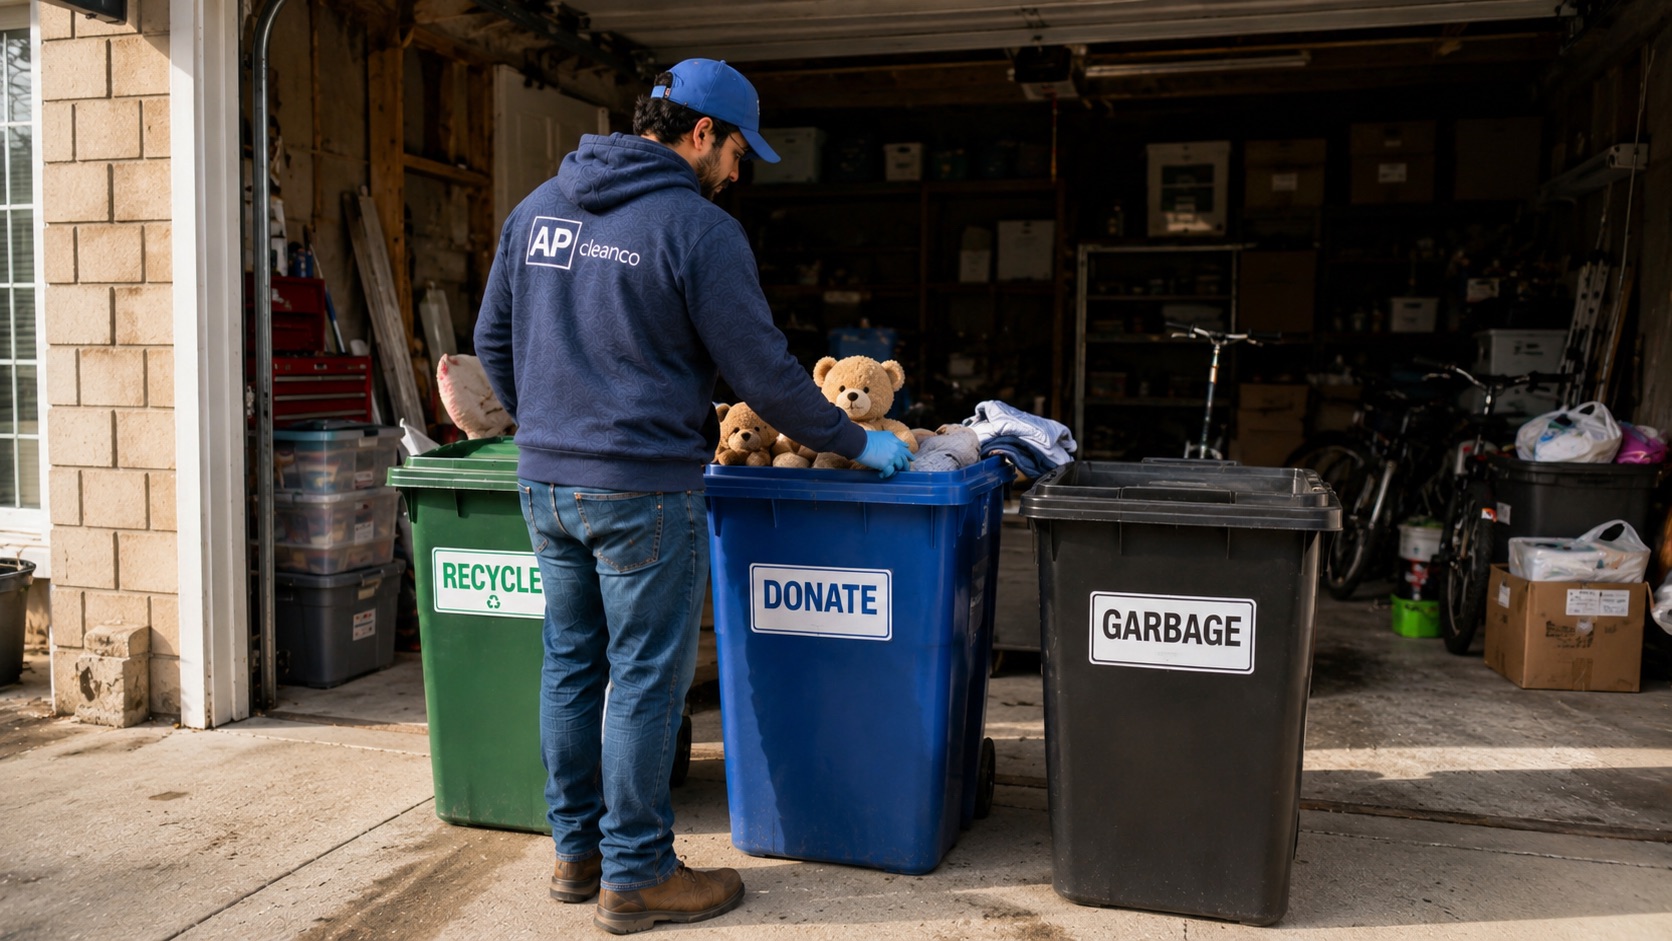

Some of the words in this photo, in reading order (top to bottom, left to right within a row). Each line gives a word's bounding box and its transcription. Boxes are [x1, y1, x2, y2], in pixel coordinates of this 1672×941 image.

[529, 226, 573, 257] AP
[579, 239, 640, 266] cleanco
[443, 562, 542, 594] RECYCLE
[764, 579, 877, 615] DONATE
[1102, 608, 1242, 647] GARBAGE
